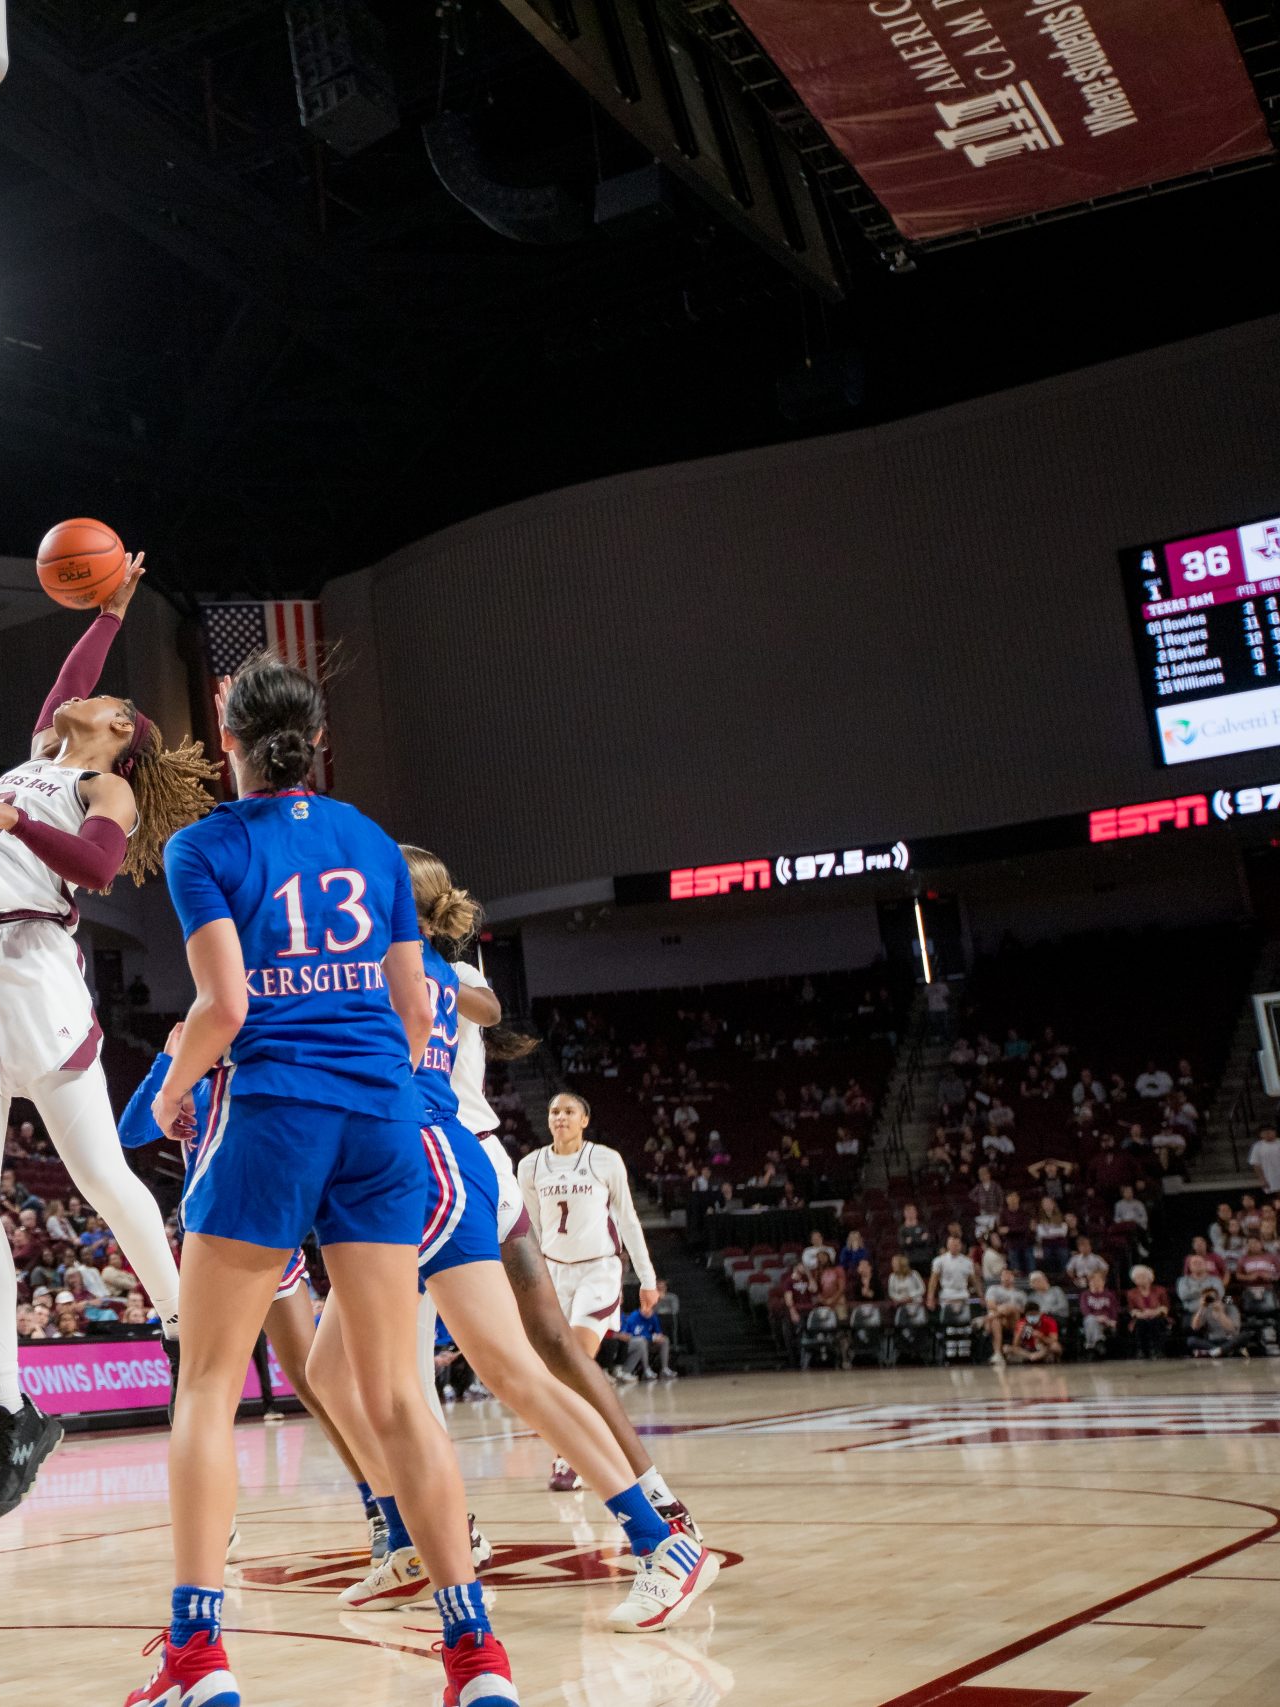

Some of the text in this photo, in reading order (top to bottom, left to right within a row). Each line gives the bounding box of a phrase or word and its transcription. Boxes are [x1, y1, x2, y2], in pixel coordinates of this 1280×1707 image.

[1038, 4, 1114, 83] students
[1078, 76, 1139, 138] Where
[1180, 545, 1231, 582] 36
[1146, 597, 1187, 617] TEXAS
[1162, 613, 1207, 633] Bowles
[1164, 628, 1209, 647] Rogers
[1170, 657, 1222, 677] Johnson
[1173, 672, 1225, 692] Williams
[1201, 711, 1268, 737] Calvetti
[24, 778, 61, 797] A&M
[1090, 794, 1208, 843] ESPN
[670, 850, 891, 899] ESPN 97.5 FM
[273, 868, 372, 958] 13
[540, 1184, 593, 1196] TEXAS A&M
[556, 1200, 569, 1235] 1
[91, 1358, 170, 1391] ACROSS
